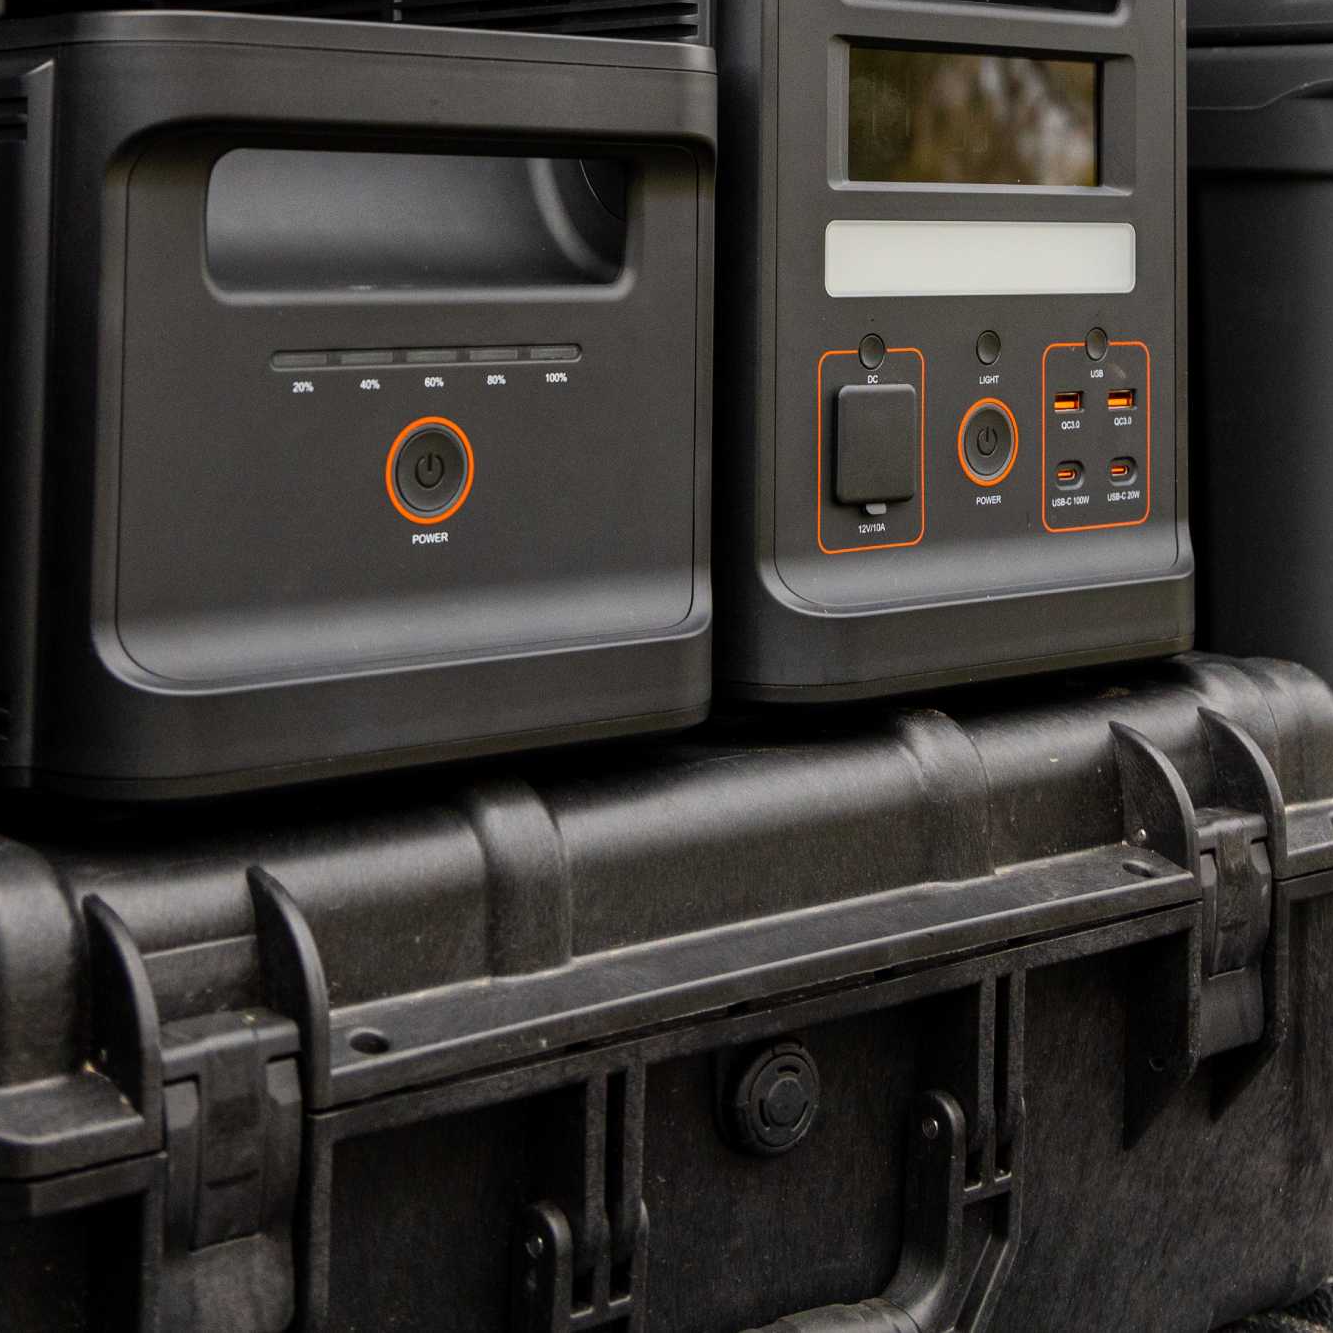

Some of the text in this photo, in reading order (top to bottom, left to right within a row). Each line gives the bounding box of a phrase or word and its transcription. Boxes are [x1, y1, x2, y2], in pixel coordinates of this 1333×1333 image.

[486, 374, 507, 386] 80%
[545, 372, 568, 384] 100%
[867, 375, 879, 384] DC
[979, 375, 1000, 385] LIGHT
[1090, 369, 1104, 379] USB
[292, 381, 315, 394] 20%
[359, 378, 381, 391] 40%
[424, 376, 445, 388] 60%
[1061, 420, 1081, 430] QC3.0
[1113, 416, 1132, 426] QC3.0
[976, 495, 1002, 505] POWER
[1052, 495, 1090, 508] USB-C 100W
[1107, 490, 1140, 502] USB-C 20W
[858, 523, 886, 534] 12V/10A
[412, 532, 449, 545] POWER
